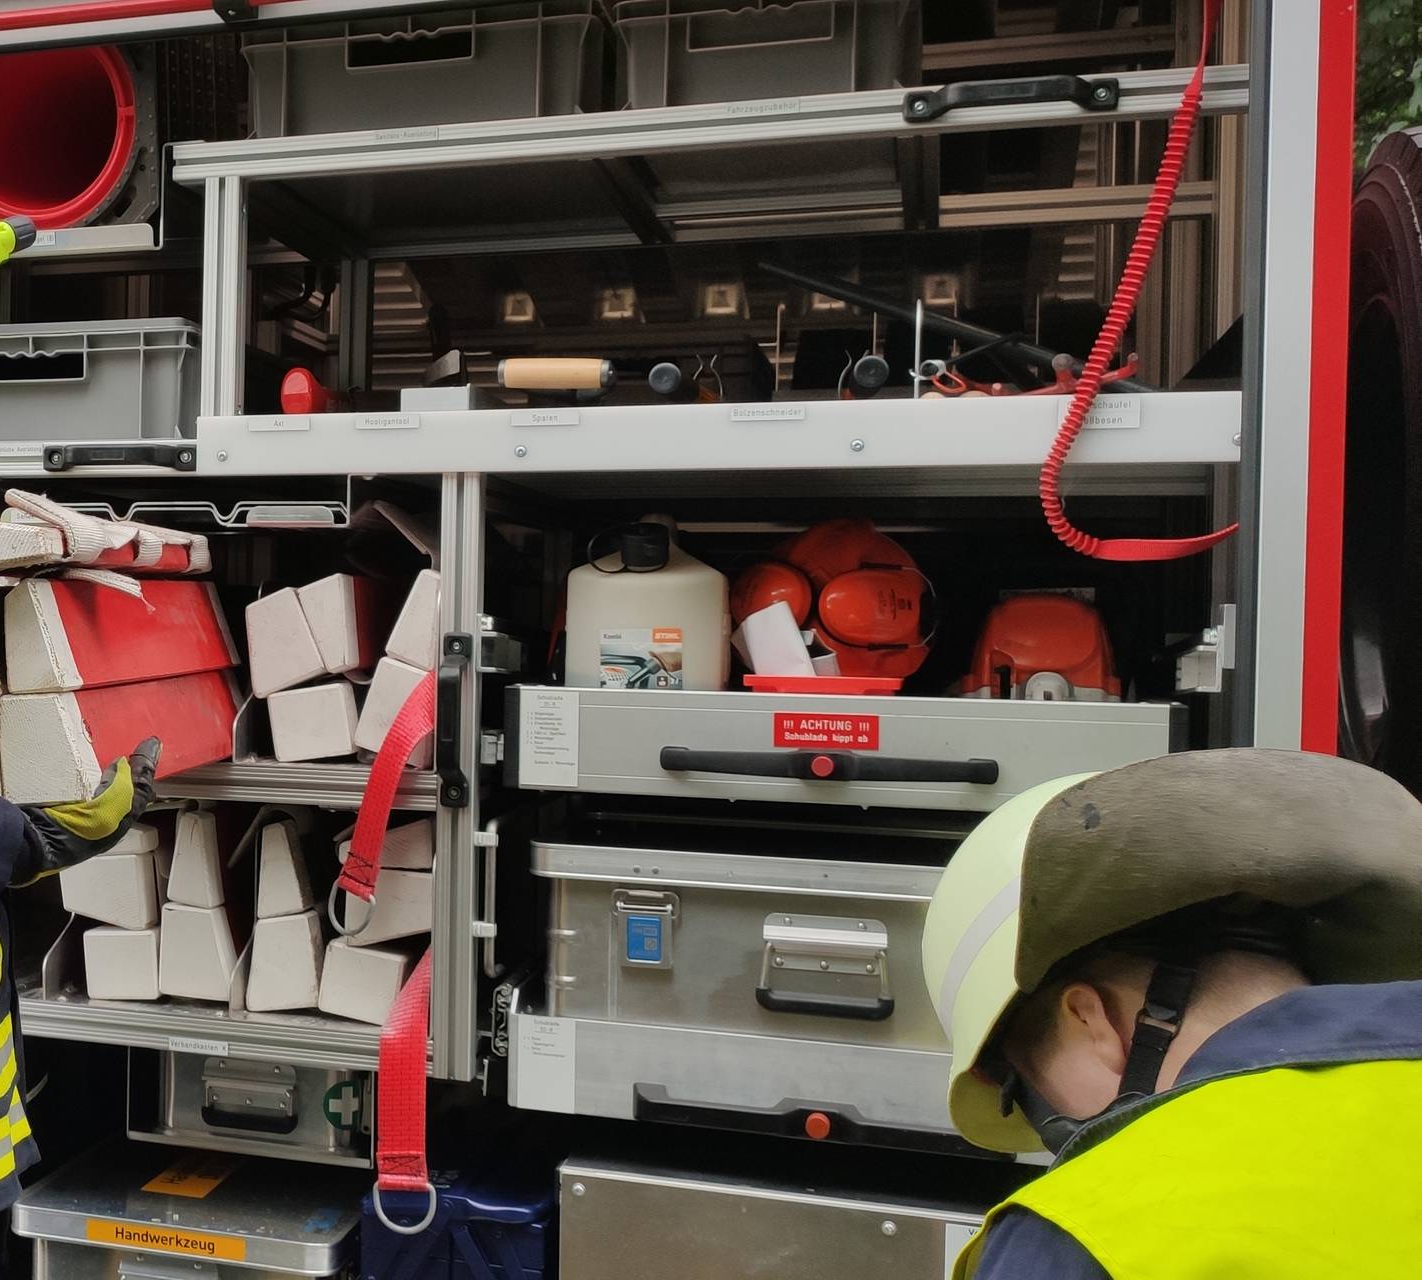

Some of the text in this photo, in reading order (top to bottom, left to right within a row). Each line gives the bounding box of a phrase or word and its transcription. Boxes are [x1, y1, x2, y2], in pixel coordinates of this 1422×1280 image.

[800, 719, 852, 731] ACHTUNG
[784, 732, 828, 741] Schublade
[833, 734, 853, 743] kippt
[115, 1226, 215, 1254] Handwerkzeug
